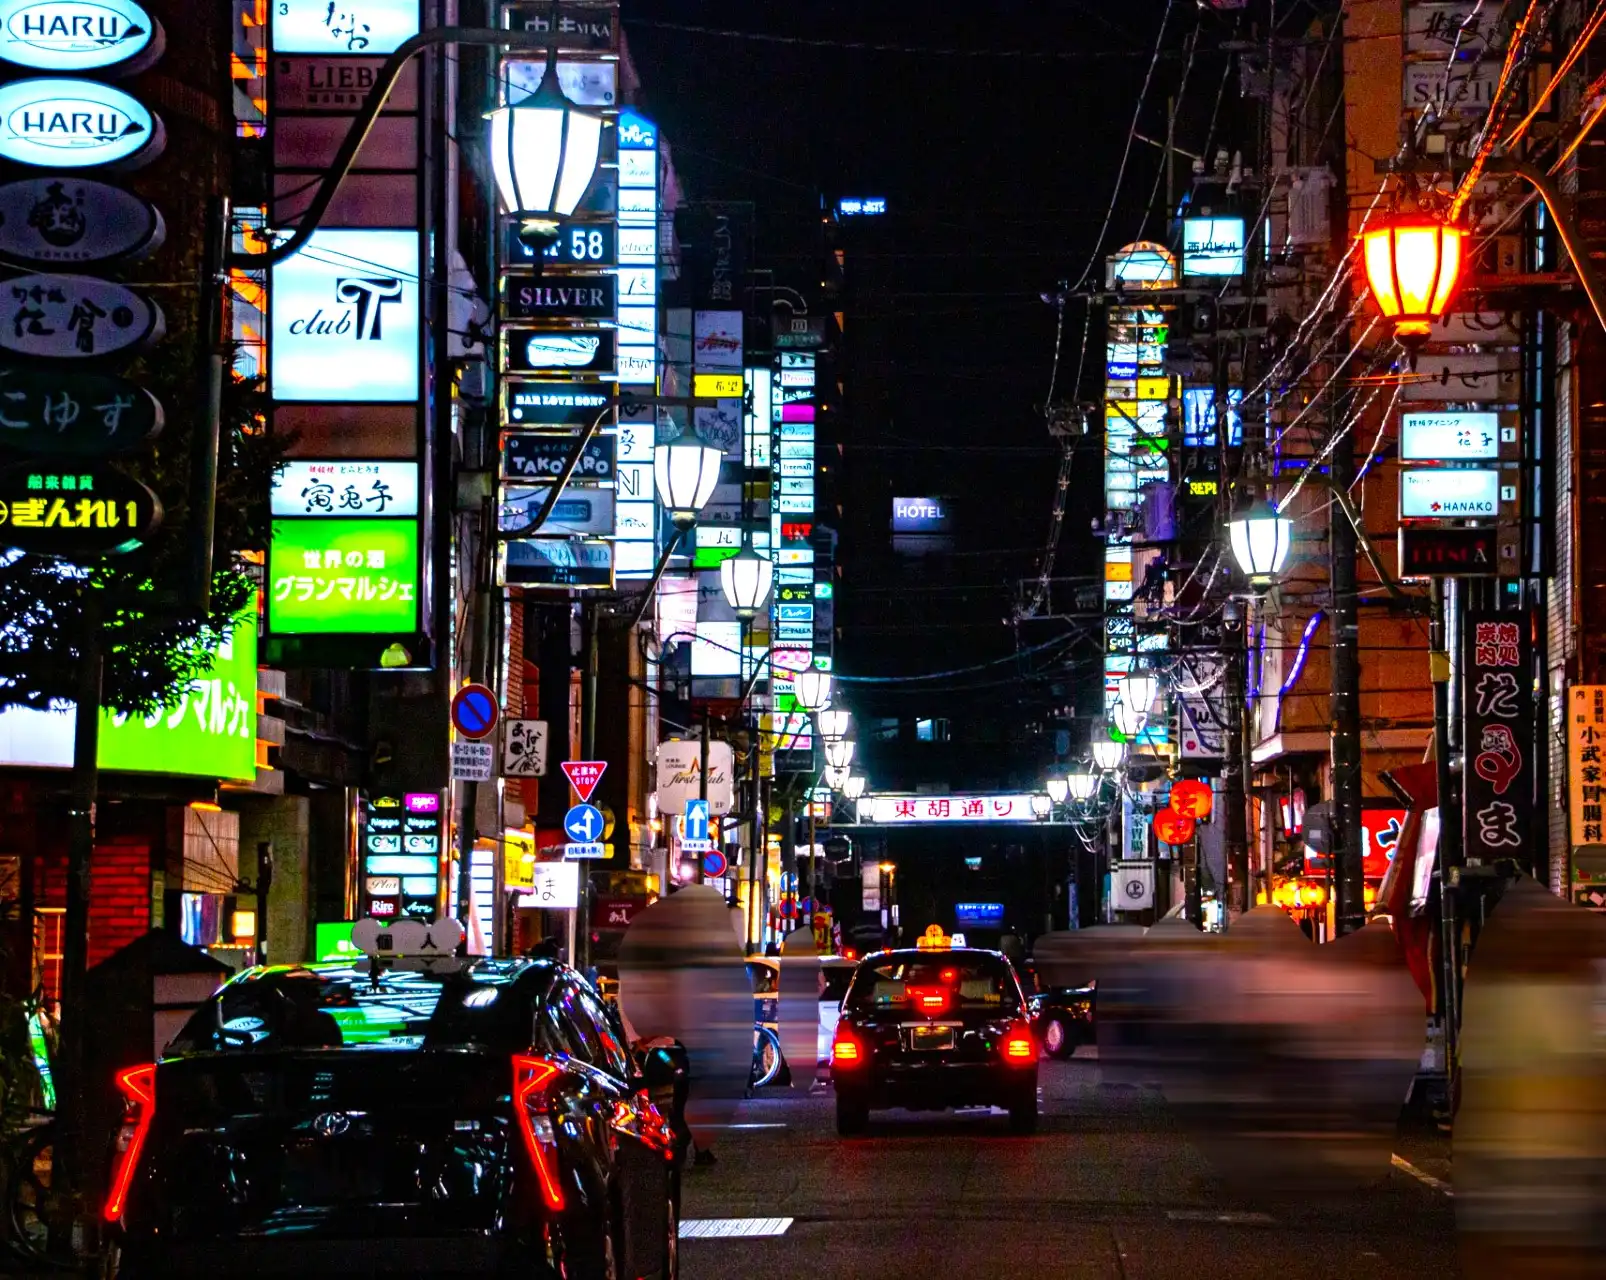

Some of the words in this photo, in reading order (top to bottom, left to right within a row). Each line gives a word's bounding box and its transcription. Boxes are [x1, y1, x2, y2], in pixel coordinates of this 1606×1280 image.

[279, 3, 289, 16] 3
[24, 15, 118, 37] HARU
[308, 65, 382, 89] LIEB
[24, 112, 118, 134] HARU
[571, 229, 604, 260] 58
[519, 287, 605, 307] SILVER
[289, 309, 351, 335] club
[1457, 430, 1494, 447] 花子
[513, 456, 609, 475] TAKOARO
[11, 498, 137, 527] ぎんれい
[896, 505, 945, 518] HOTEL
[1443, 502, 1493, 512] HANAKO
[303, 550, 385, 569] 世界の酒
[275, 574, 413, 602] グランマルシェ
[571, 766, 598, 776] 止まれ
[575, 776, 595, 785] STOP
[894, 799, 1013, 818] 東胡通り
